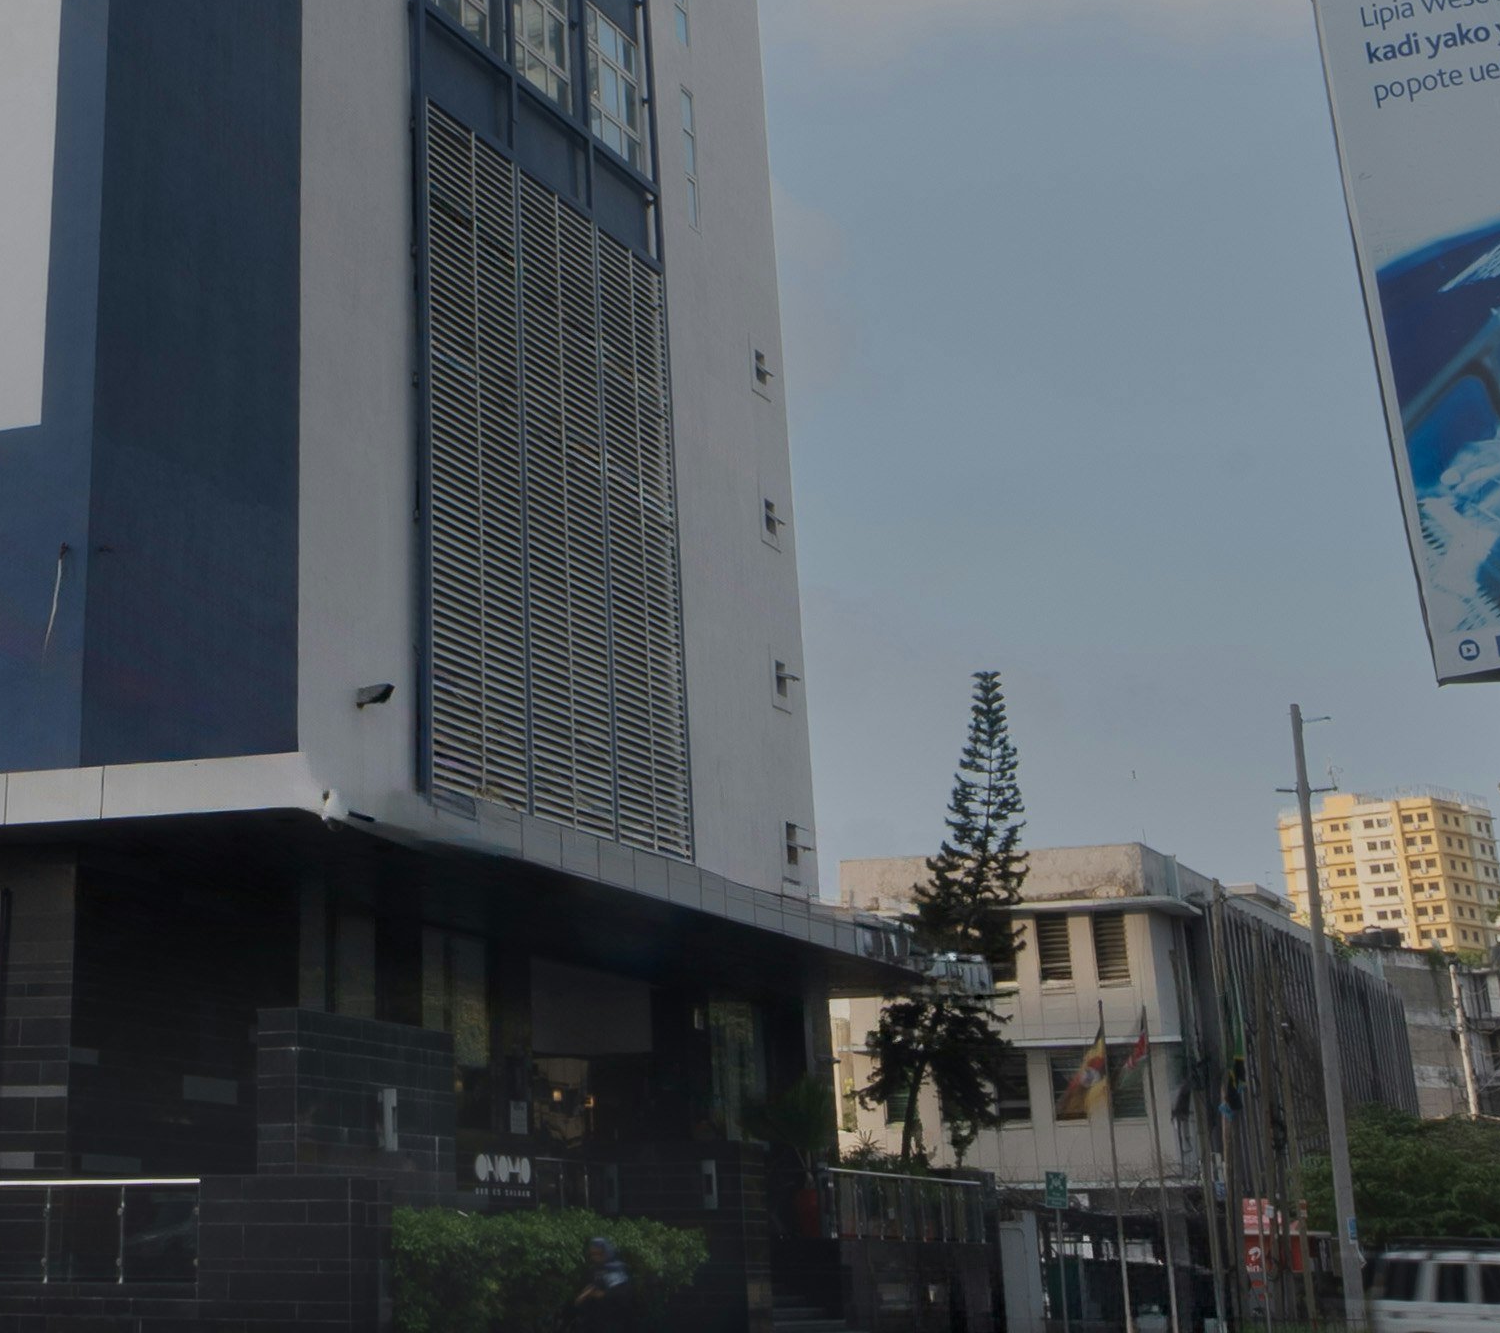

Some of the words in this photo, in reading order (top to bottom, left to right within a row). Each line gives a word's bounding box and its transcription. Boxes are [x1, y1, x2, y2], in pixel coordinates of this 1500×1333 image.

[1365, 31, 1421, 64] kadi
[1425, 23, 1490, 59] yako
[1374, 67, 1464, 108] popote
